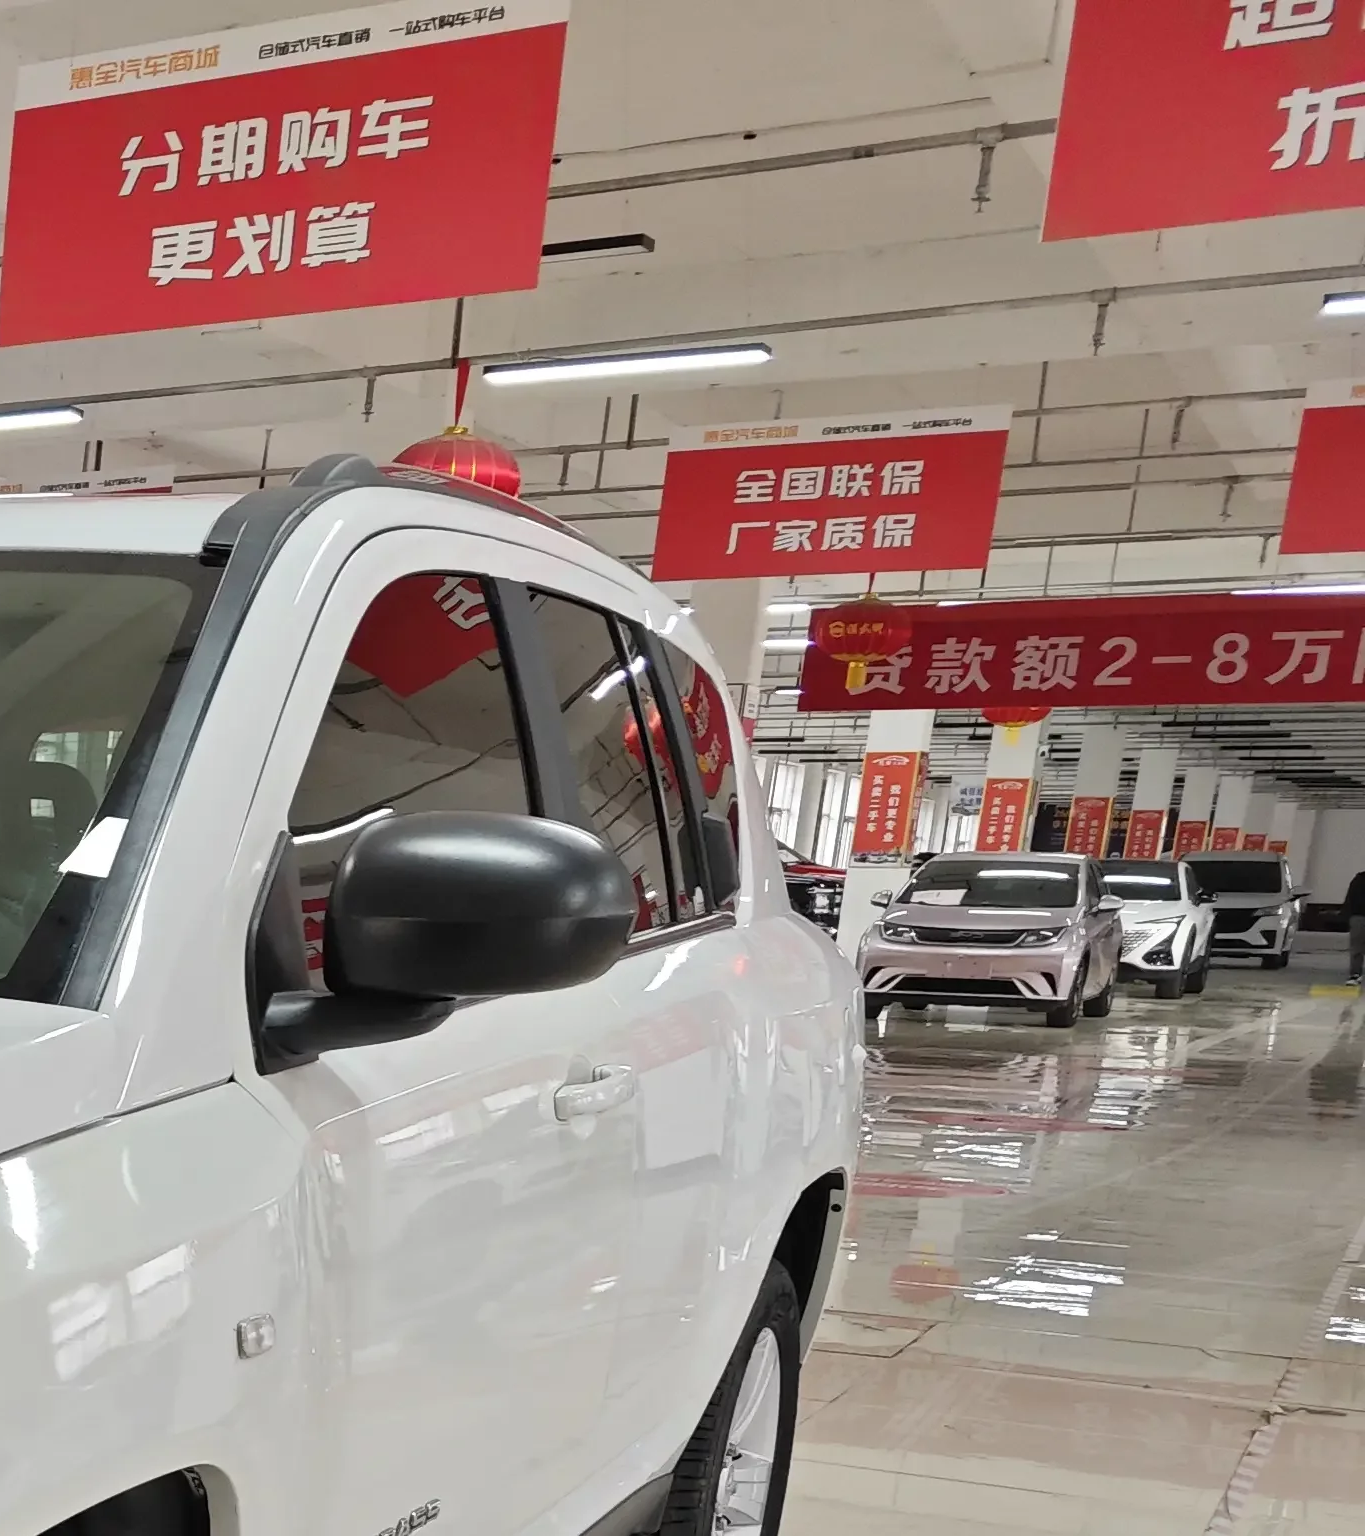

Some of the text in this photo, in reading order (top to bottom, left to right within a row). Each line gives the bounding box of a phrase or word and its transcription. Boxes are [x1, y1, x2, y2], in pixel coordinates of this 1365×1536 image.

[68, 6, 506, 91] 惠全汽车商城 仓储式汽车直销 一站式购车平台
[118, 95, 433, 197] 分期购车
[148, 201, 377, 287] 更划算
[733, 460, 925, 504] 全国联保
[725, 513, 917, 555] 厂家质保
